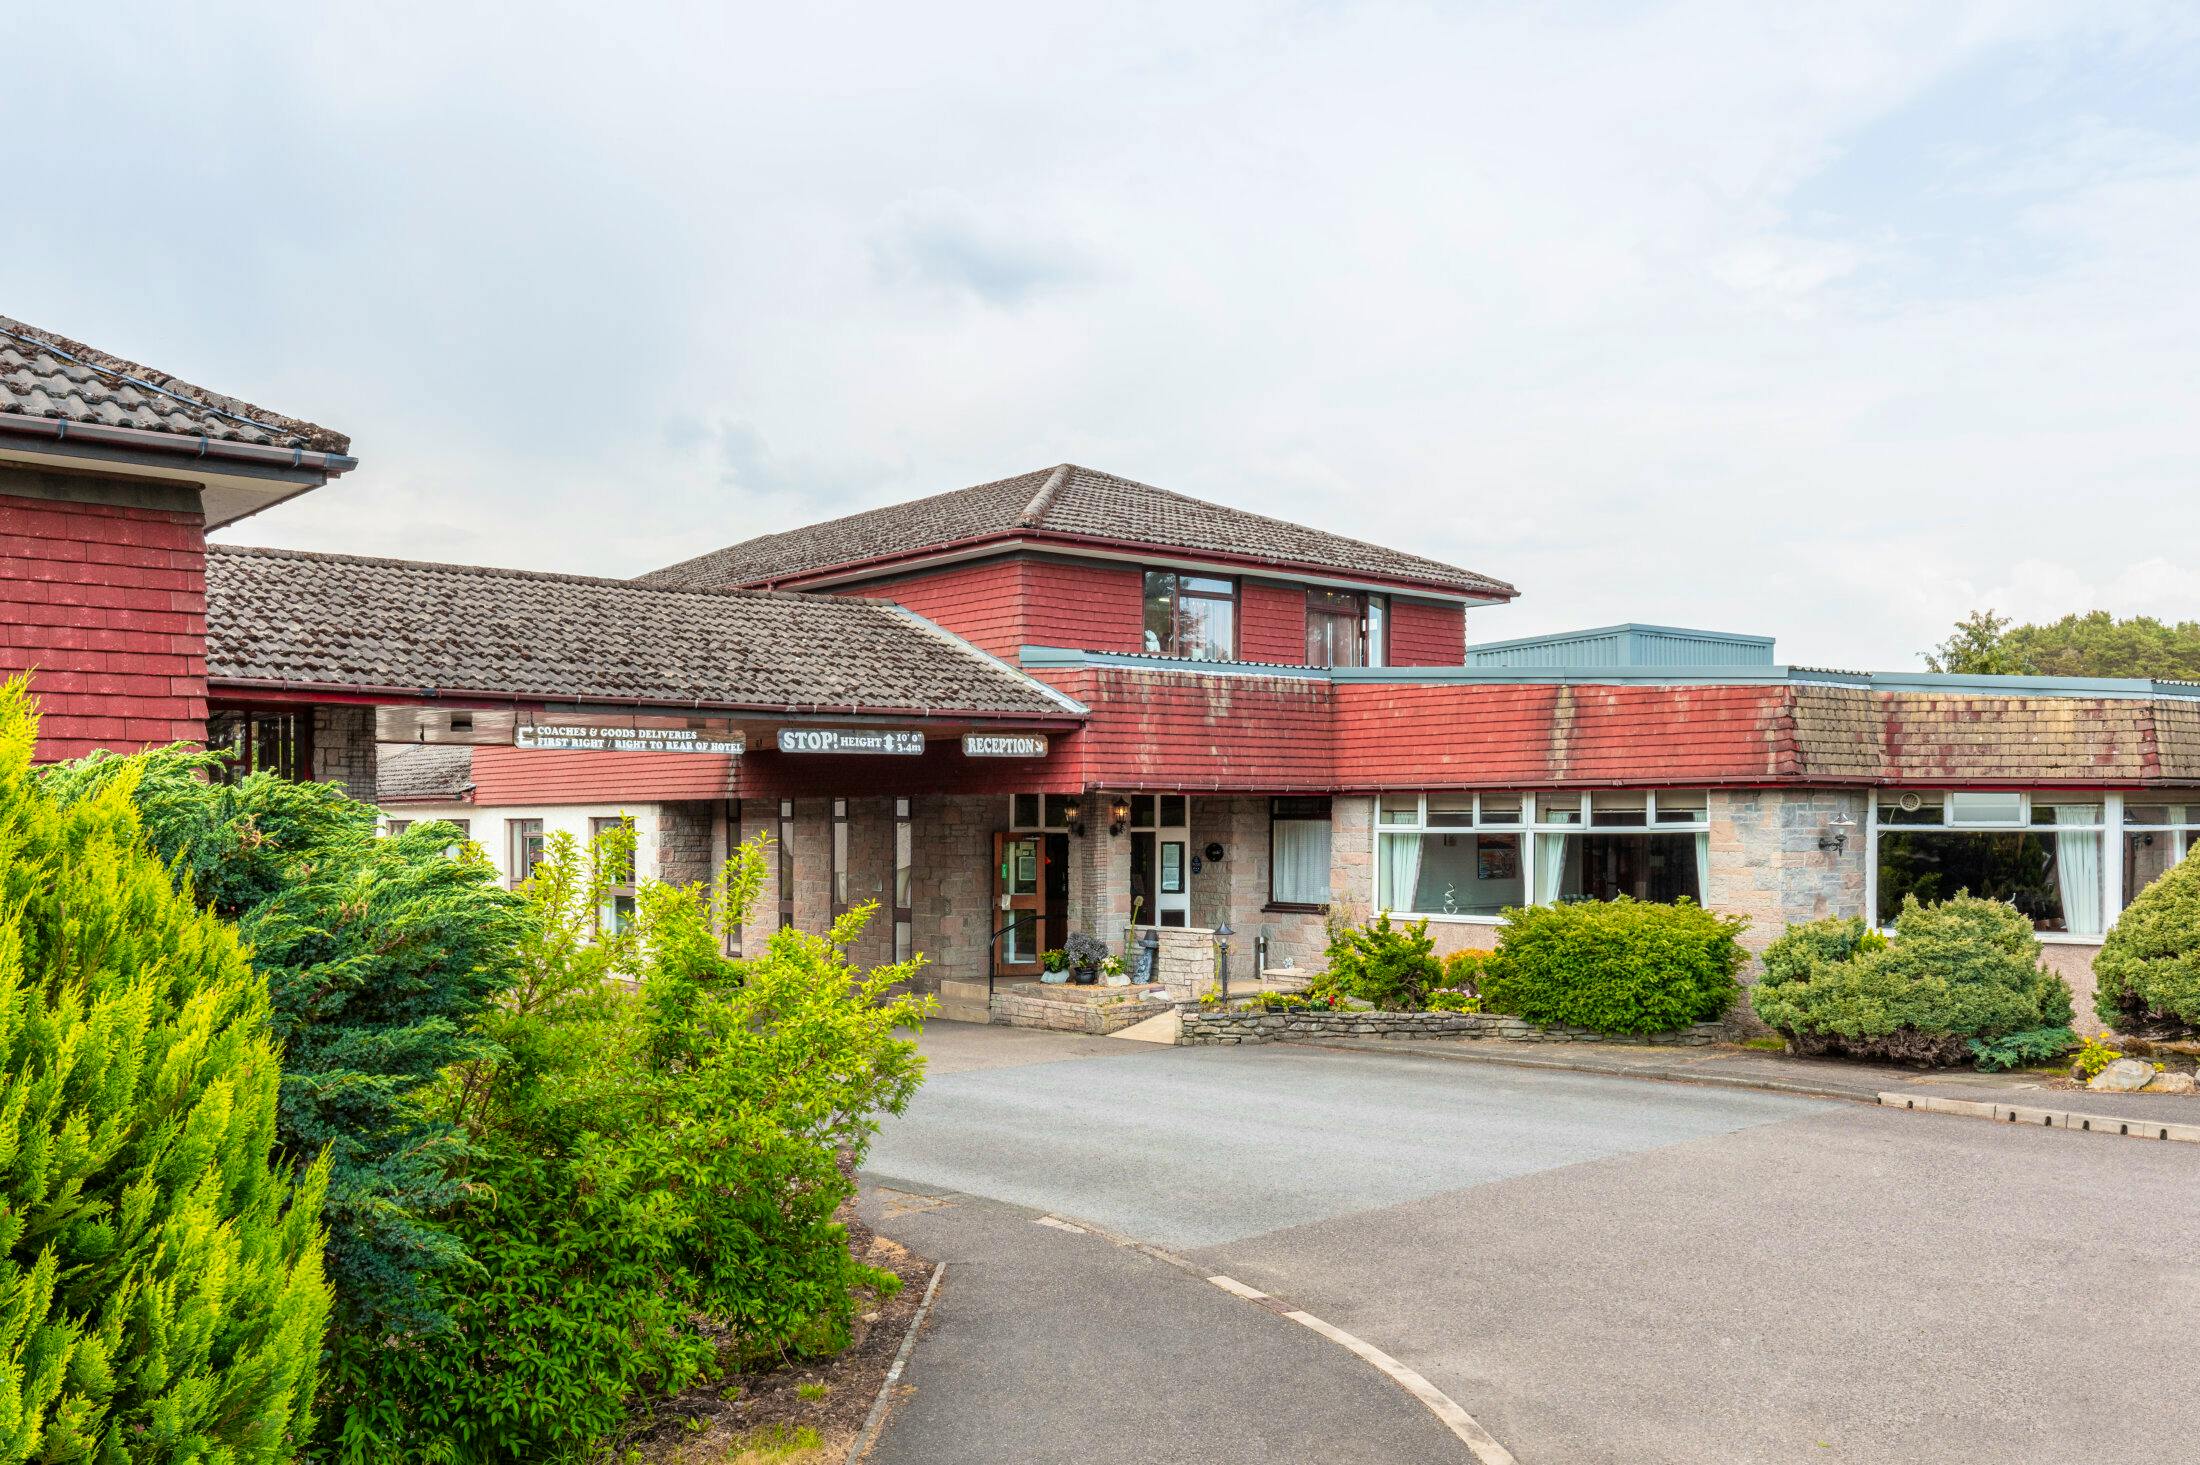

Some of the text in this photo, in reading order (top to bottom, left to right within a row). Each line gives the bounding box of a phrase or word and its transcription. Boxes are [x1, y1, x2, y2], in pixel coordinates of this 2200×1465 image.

[537, 727, 697, 740] COACHES & GOODS DELIVERIES
[783, 731, 882, 750] STOP! HEIGHT
[537, 737, 570, 747] FIRST
[571, 738, 605, 748] RIGHT
[614, 739, 647, 749] RIGHT
[649, 740, 663, 750] TO
[665, 741, 693, 751] REAR
[695, 742, 709, 751] OF
[710, 742, 743, 752] HOTEL
[967, 737, 1035, 754] RECEPTION
